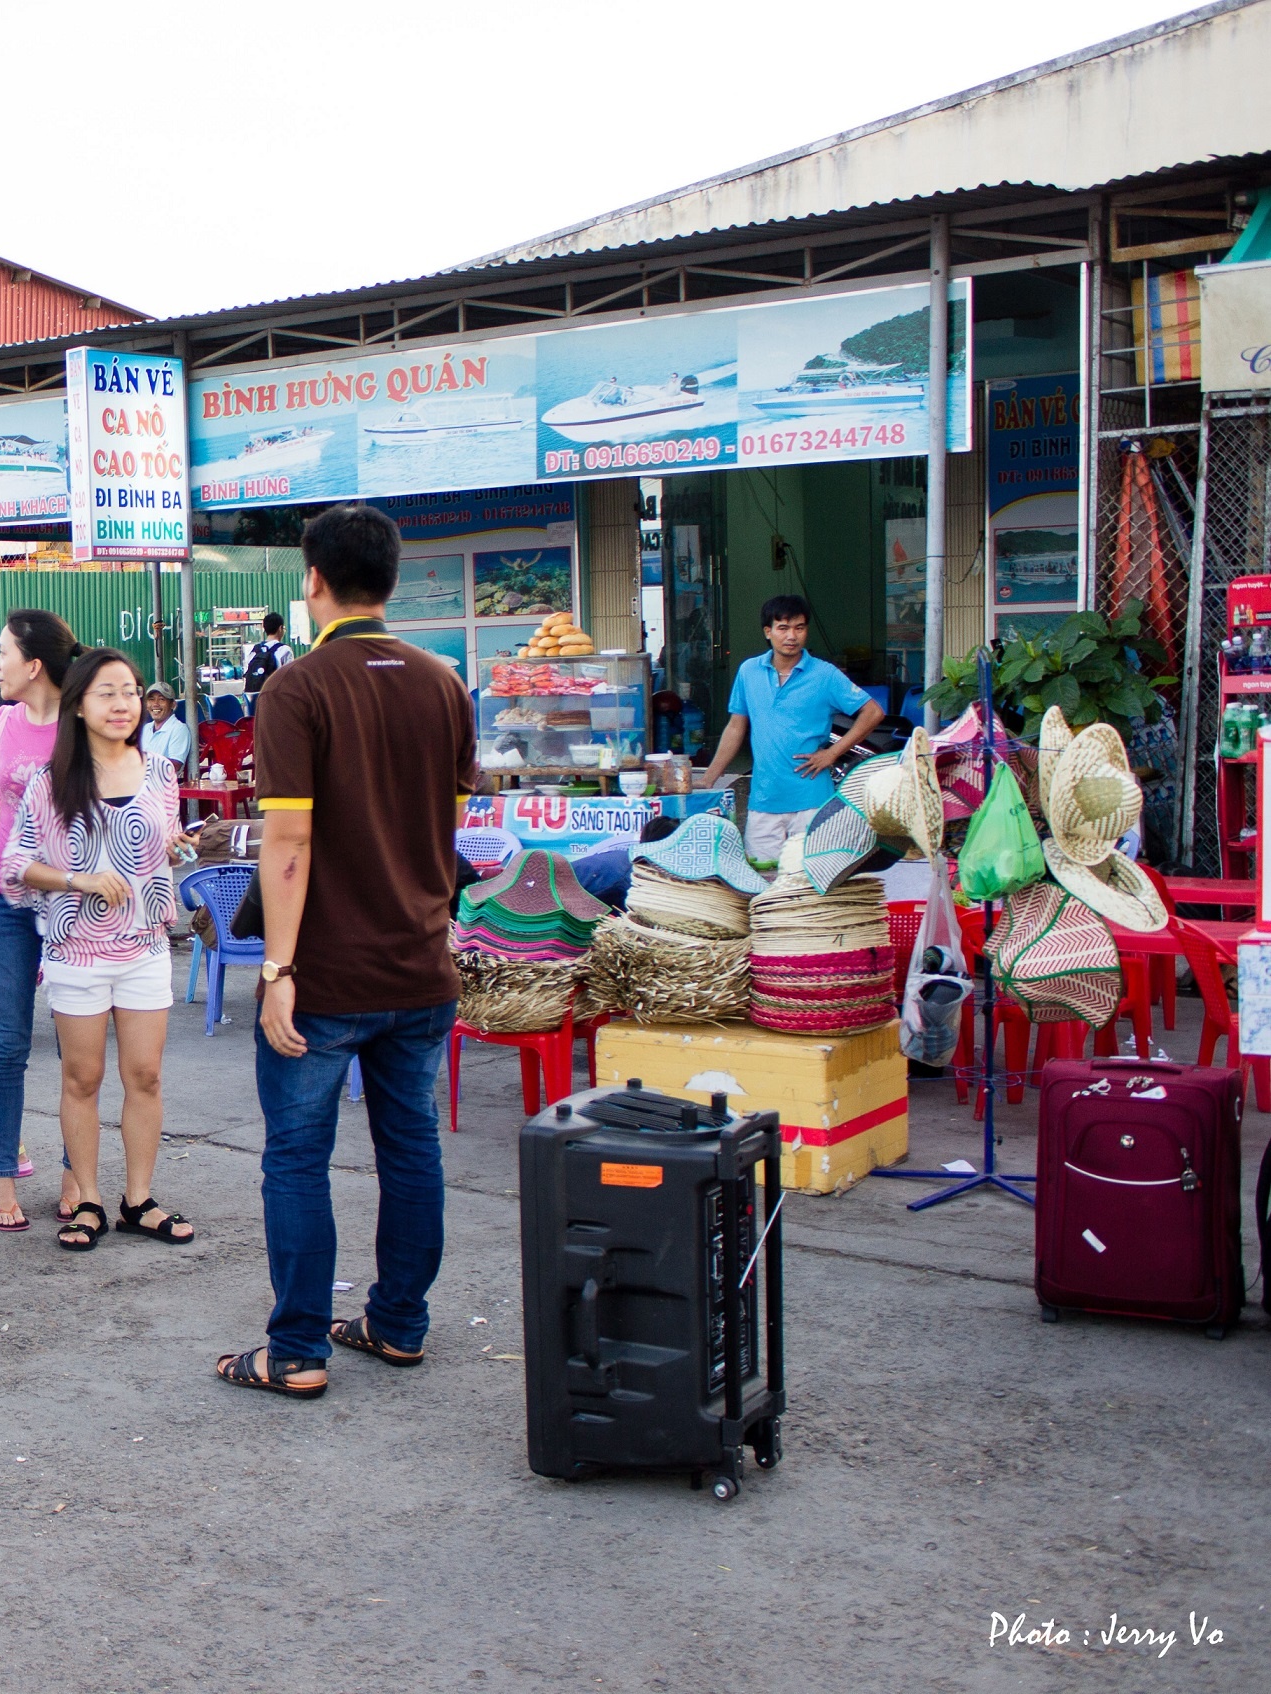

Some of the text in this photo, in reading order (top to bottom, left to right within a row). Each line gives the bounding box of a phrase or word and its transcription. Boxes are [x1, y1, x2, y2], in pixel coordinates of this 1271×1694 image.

[93, 357, 174, 396] BÁN VÉ
[203, 353, 488, 419] BÌNH HƯNG QUÁN
[102, 403, 165, 437] CA NÔ
[994, 390, 1036, 431] BÁN
[1040, 386, 1067, 427] VÉ
[93, 440, 182, 479] CAO TỐC
[545, 451, 580, 472] ĐT:
[585, 437, 719, 470] 0916650249
[741, 423, 906, 456] 01673244748
[1010, 433, 1071, 459] ĐI BÌNH
[96, 484, 182, 509] ĐI BÌNH BA
[201, 476, 289, 501] BÌNH HƯNG
[20, 494, 67, 516] KHÁCH
[97, 515, 183, 541] BÌNH HƯNG
[571, 805, 604, 831] SÁNG
[606, 810, 631, 836] TẠO
